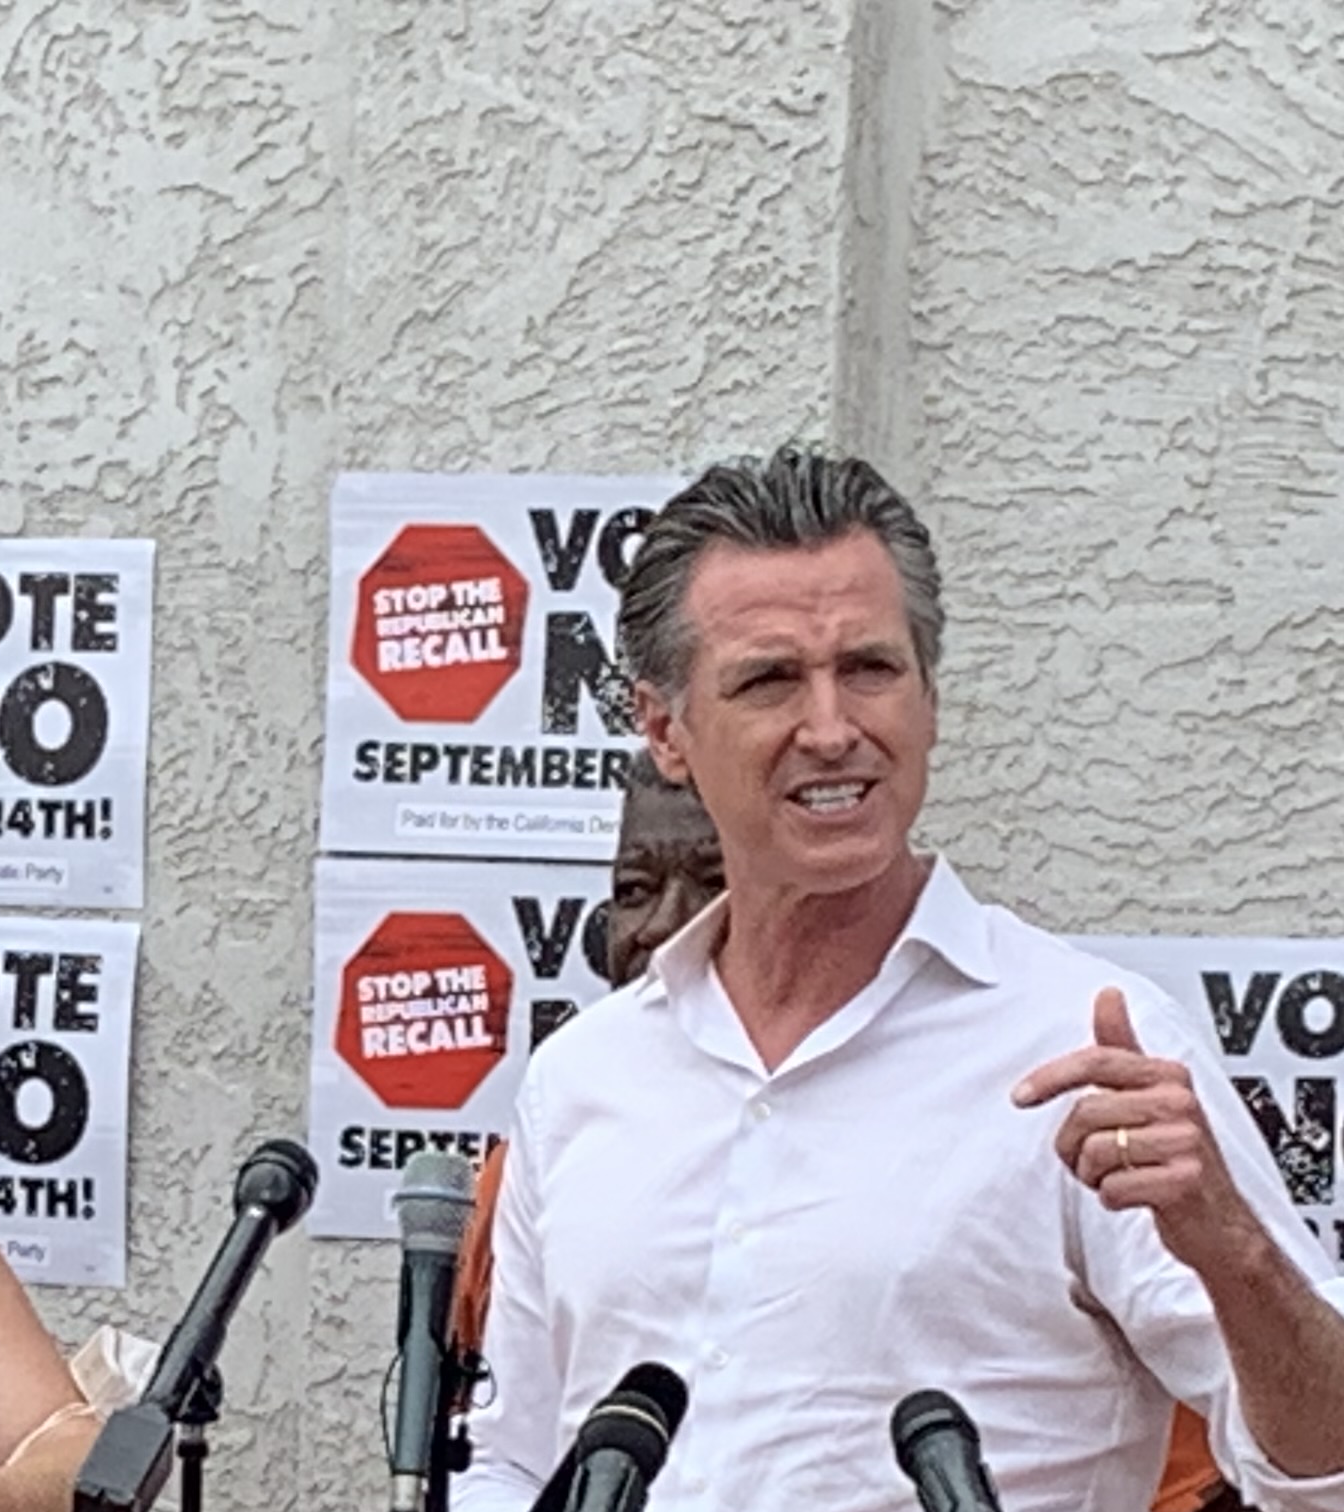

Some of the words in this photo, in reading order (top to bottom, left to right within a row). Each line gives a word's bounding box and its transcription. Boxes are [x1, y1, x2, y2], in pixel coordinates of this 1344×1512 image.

[528, 506, 657, 592] VO
[373, 584, 448, 615] STOP
[450, 577, 503, 606] THE
[376, 604, 505, 638] REPUBLICAN
[378, 627, 508, 673] RECALL
[541, 611, 644, 736] N
[353, 741, 631, 791] SEPTEMBER
[401, 807, 435, 829] Paid
[513, 813, 585, 834] California
[25, 864, 64, 885] Party
[357, 971, 432, 1002] STOP
[434, 964, 487, 993] THE
[361, 991, 489, 1024] REPUBLICAN
[362, 1015, 493, 1060] RECALL
[338, 1125, 501, 1171] SEPTE
[7, 1240, 47, 1264] Party
